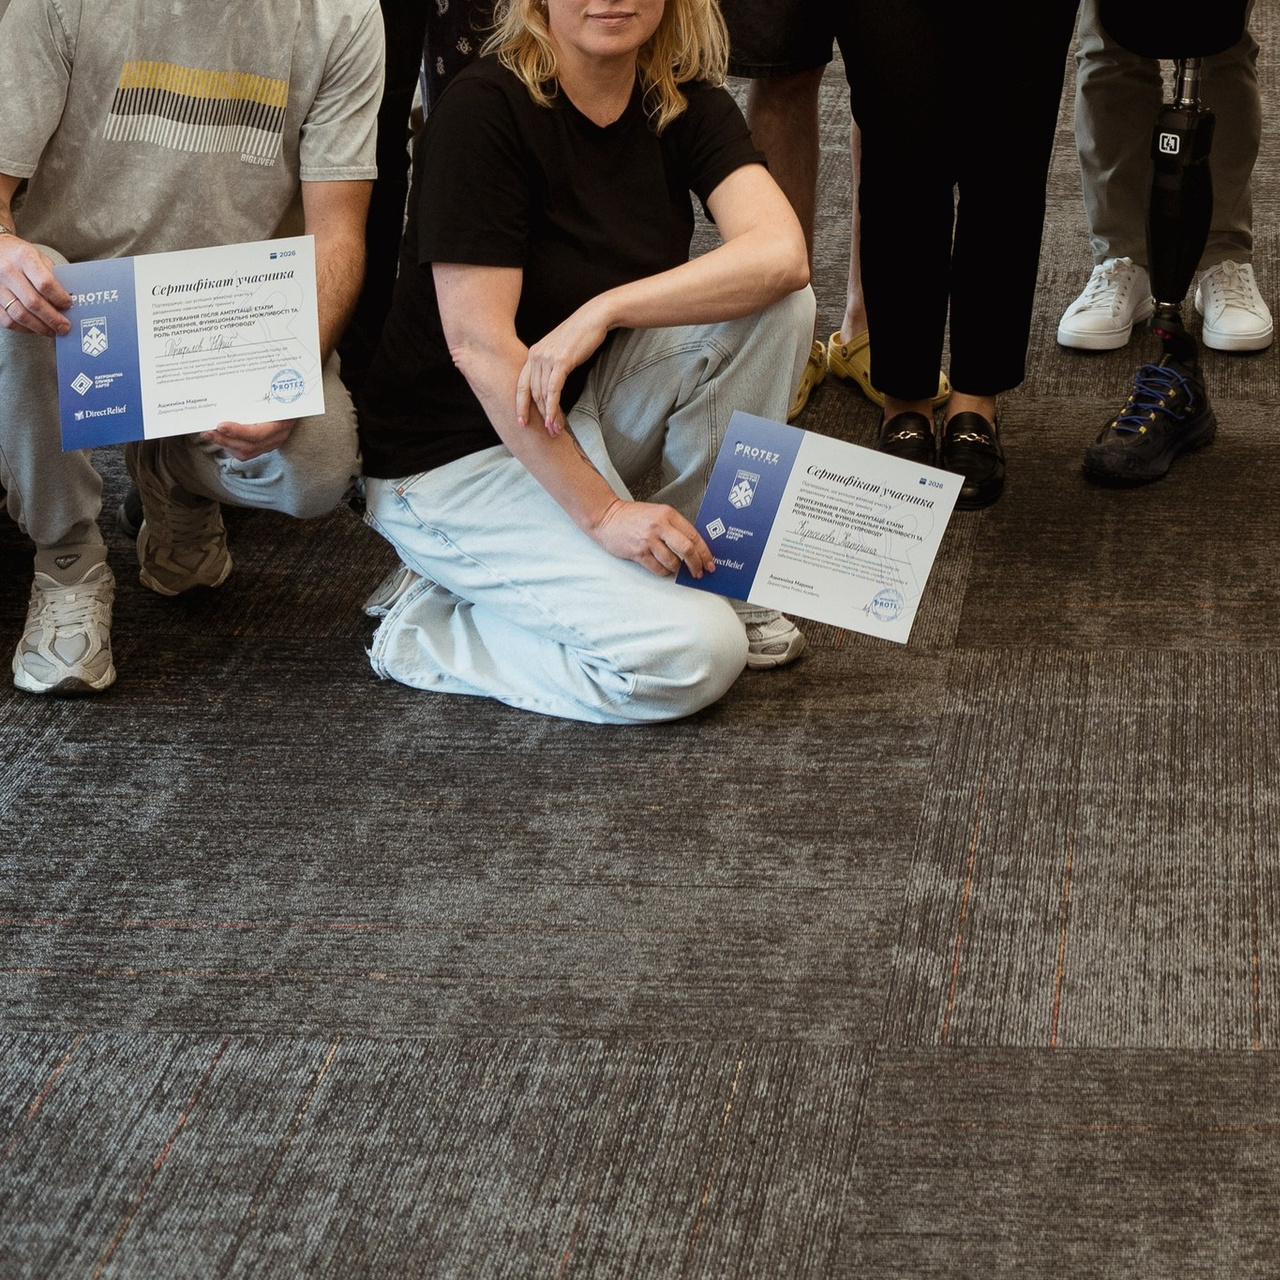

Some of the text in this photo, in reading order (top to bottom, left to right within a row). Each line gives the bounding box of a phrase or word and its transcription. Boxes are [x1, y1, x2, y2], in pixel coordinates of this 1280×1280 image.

[151, 270, 293, 295] Сертифікат учасника
[71, 289, 118, 303] PROTEZ
[152, 314, 199, 324] ПРОТЕЗУВАННЯ
[198, 314, 248, 325] ФУНКЦІОНАЛЬНІ
[249, 309, 289, 318] МОЖЛИВОСТІ
[171, 325, 218, 335] ПАТРОНАТНОГО
[219, 320, 255, 329] СУПРОВОДУ
[271, 380, 305, 392] PROTEZ
[85, 404, 126, 417] Direct Relief
[735, 442, 779, 462] PROTEZ
[807, 466, 880, 492] Сертифікат
[879, 488, 933, 508] учасника
[928, 480, 943, 488] 2026
[725, 559, 744, 569] Relief
